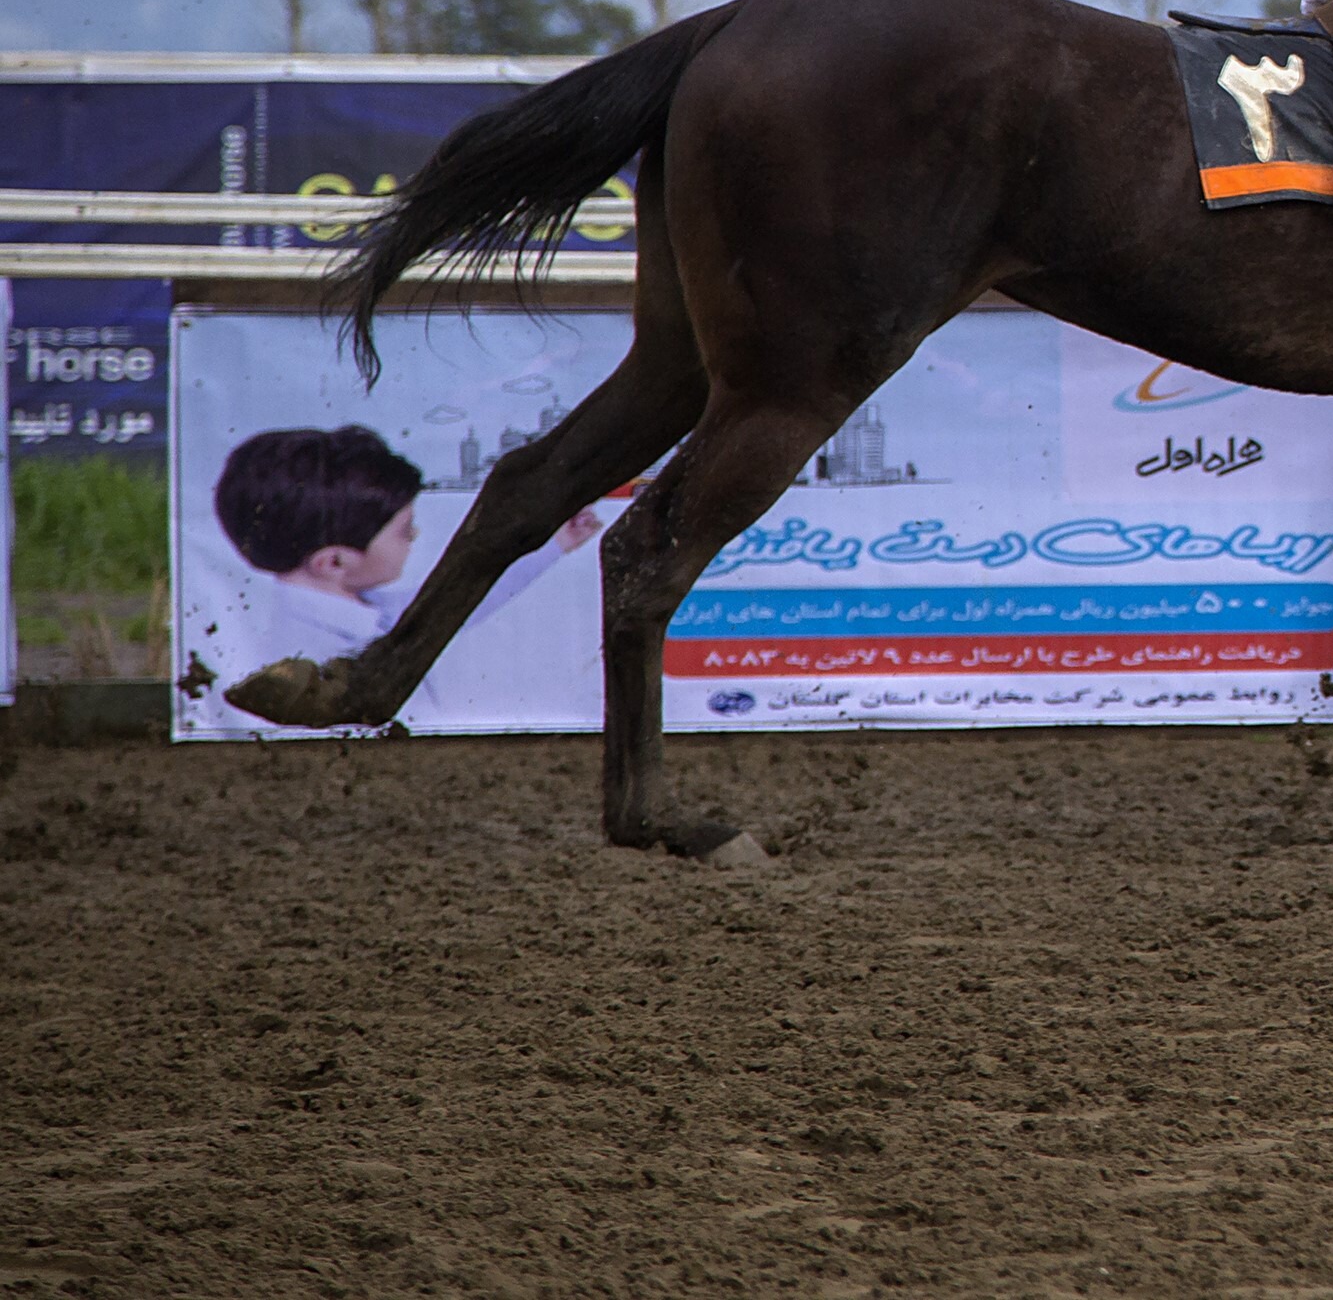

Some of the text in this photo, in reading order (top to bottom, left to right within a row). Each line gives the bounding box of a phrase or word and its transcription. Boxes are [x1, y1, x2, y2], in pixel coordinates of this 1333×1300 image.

[26, 332, 155, 382] horse
[908, 650, 955, 665] عدد
[961, 647, 1032, 668] ارسال
[1037, 646, 1056, 667] با
[1060, 647, 1116, 668] طرح
